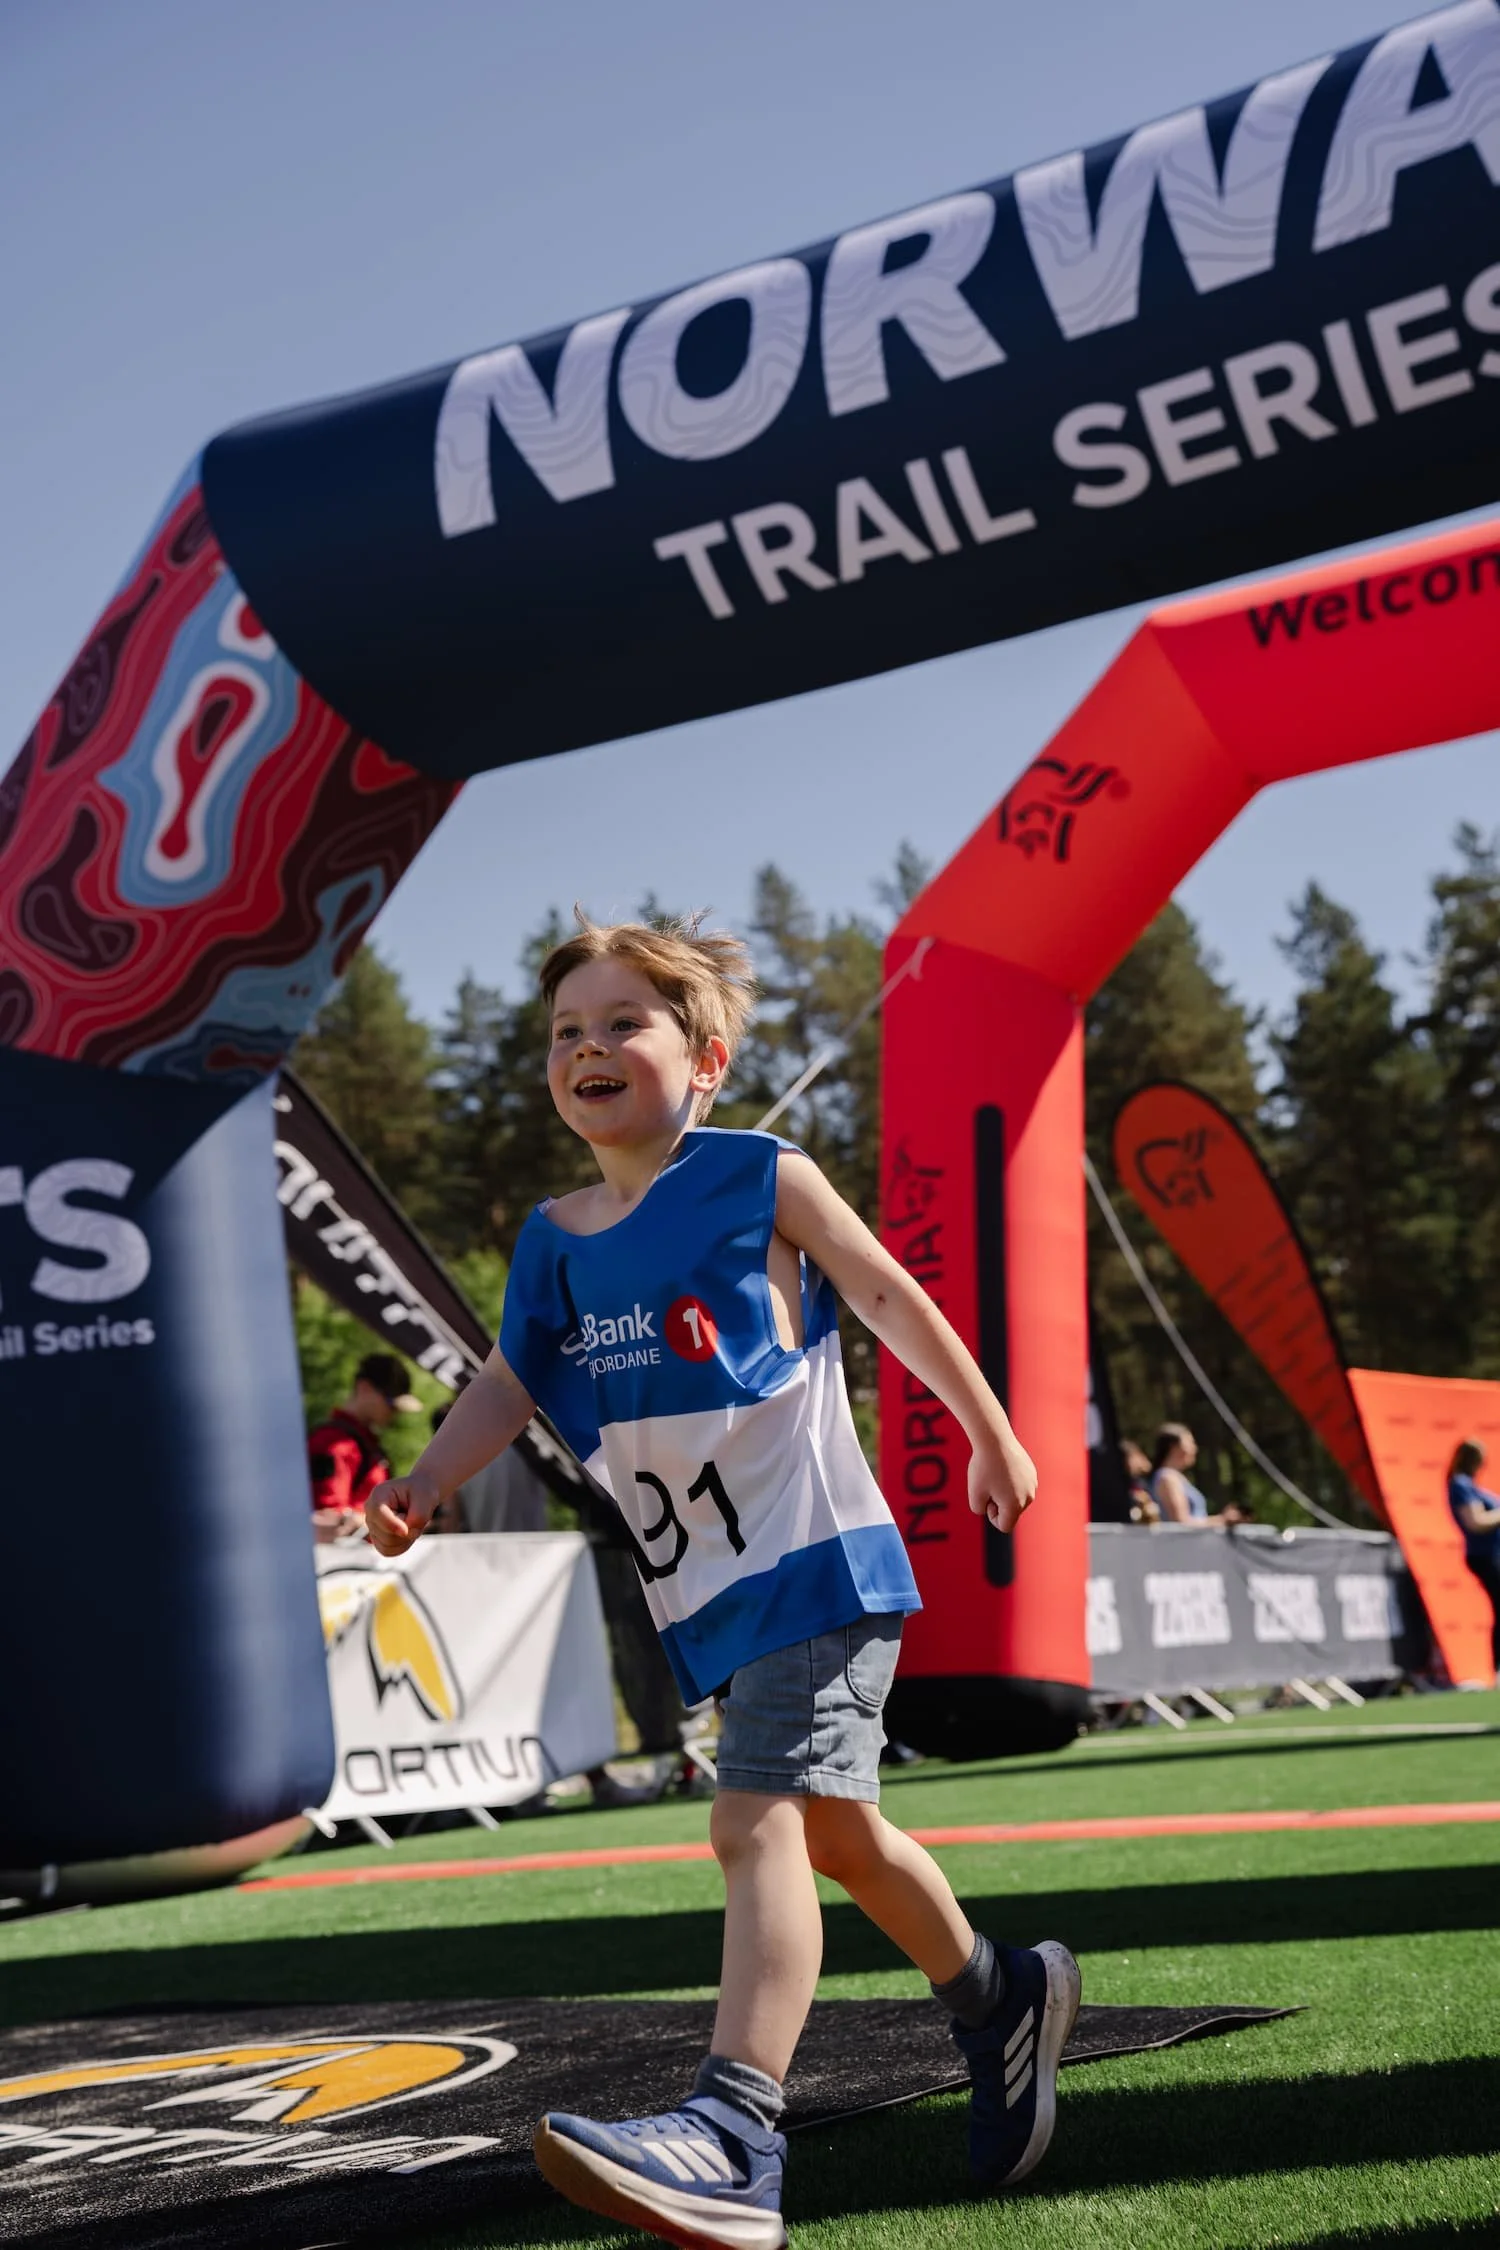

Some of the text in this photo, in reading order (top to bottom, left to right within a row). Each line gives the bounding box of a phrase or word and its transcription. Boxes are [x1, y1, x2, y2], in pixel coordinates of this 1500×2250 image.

[434, 0, 1500, 539] NORWA
[653, 445, 1036, 620] TRAIL
[0, 1157, 151, 1302] S
[32, 1314, 156, 1355] Series
